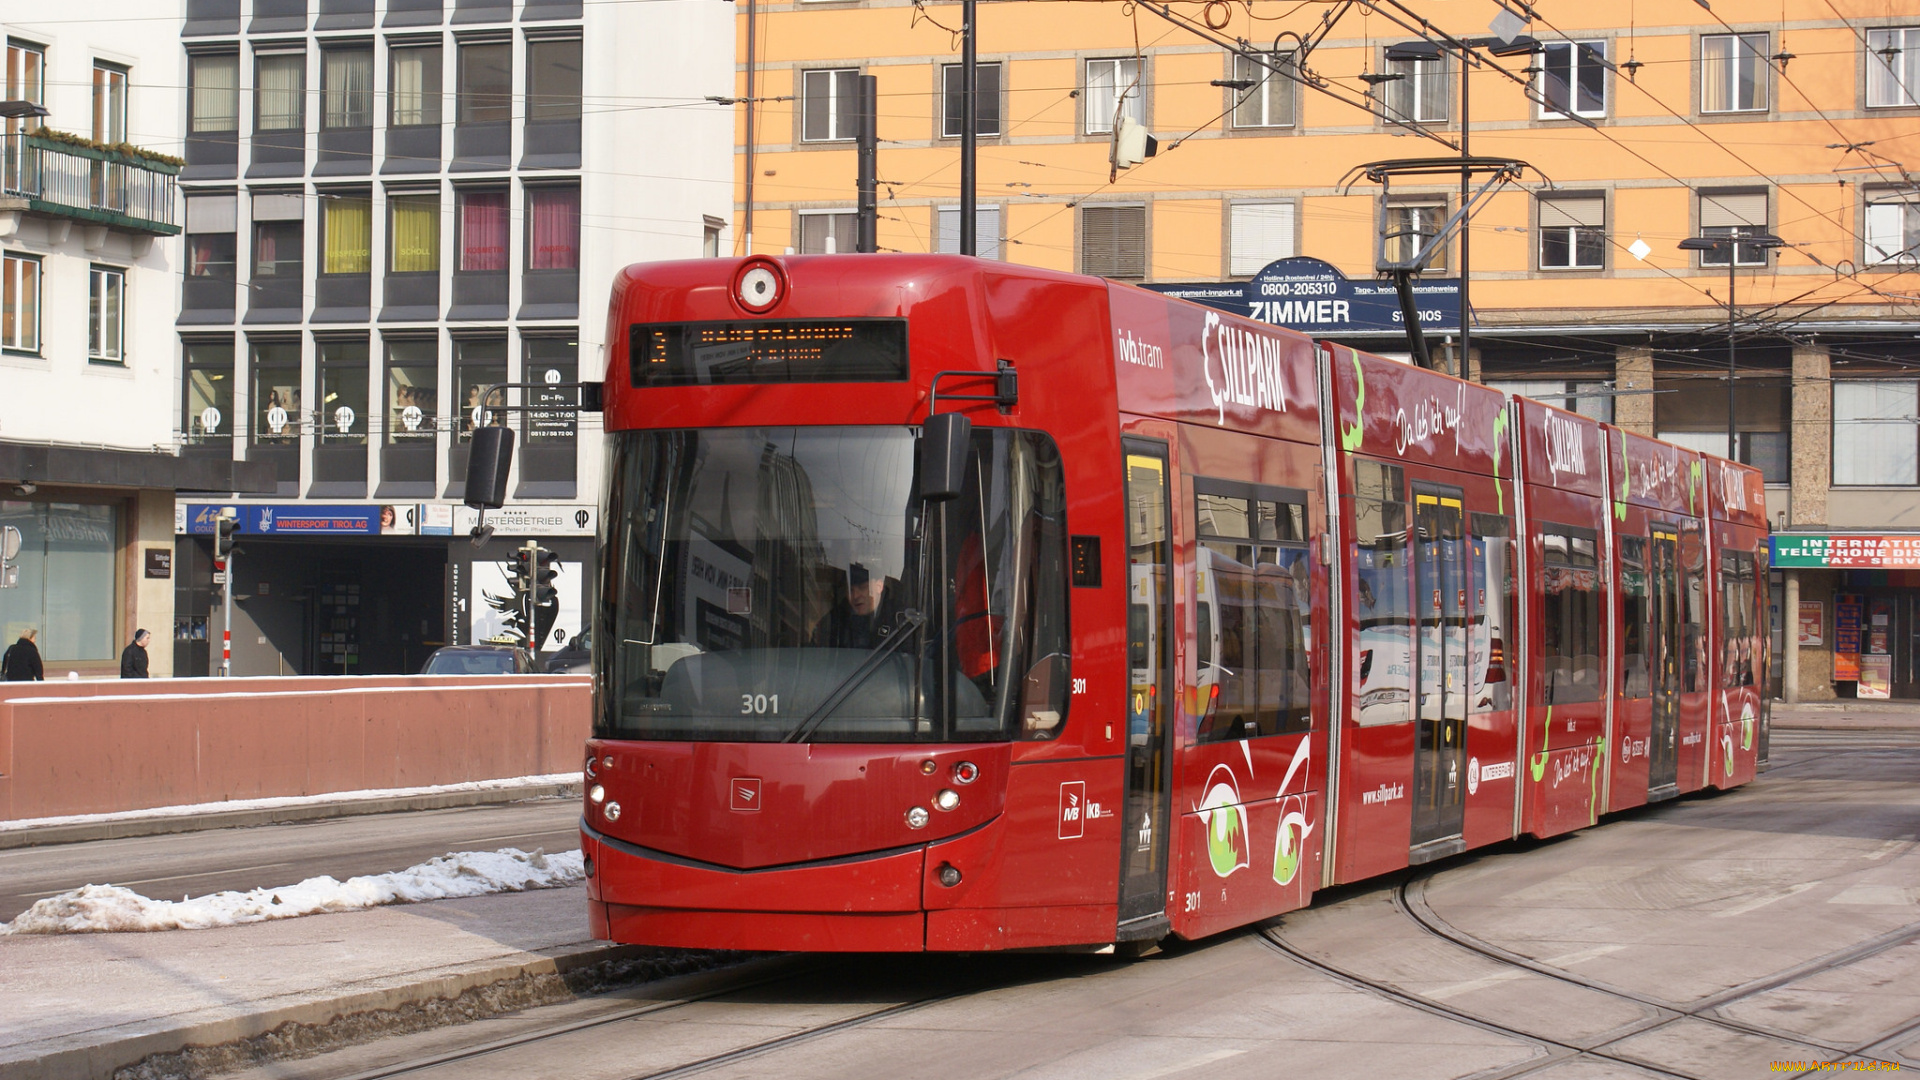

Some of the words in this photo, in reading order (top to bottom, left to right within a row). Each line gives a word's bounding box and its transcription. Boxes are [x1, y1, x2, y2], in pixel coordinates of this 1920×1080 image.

[1261, 283, 1337, 295] 0800-205310
[1248, 301, 1350, 324] ZIMMER
[1392, 310, 1442, 322] STDIOS
[1118, 329, 1164, 370] ivb.tram
[1218, 324, 1287, 413] SILLPARK
[1396, 407, 1415, 456] Da
[276, 520, 330, 529] WINTERSPORT
[332, 520, 353, 529] TIROL
[355, 520, 368, 529] AG
[468, 516, 563, 525] MISTERBETRIEB
[1778, 548, 1887, 557] TELEPHONE
[458, 598, 466, 612] 1
[1072, 678, 1086, 694] 301
[741, 694, 779, 715] 301
[1363, 782, 1404, 807] www.sillpark.at
[1063, 807, 1080, 821] IVB
[1184, 890, 1201, 912] 301
